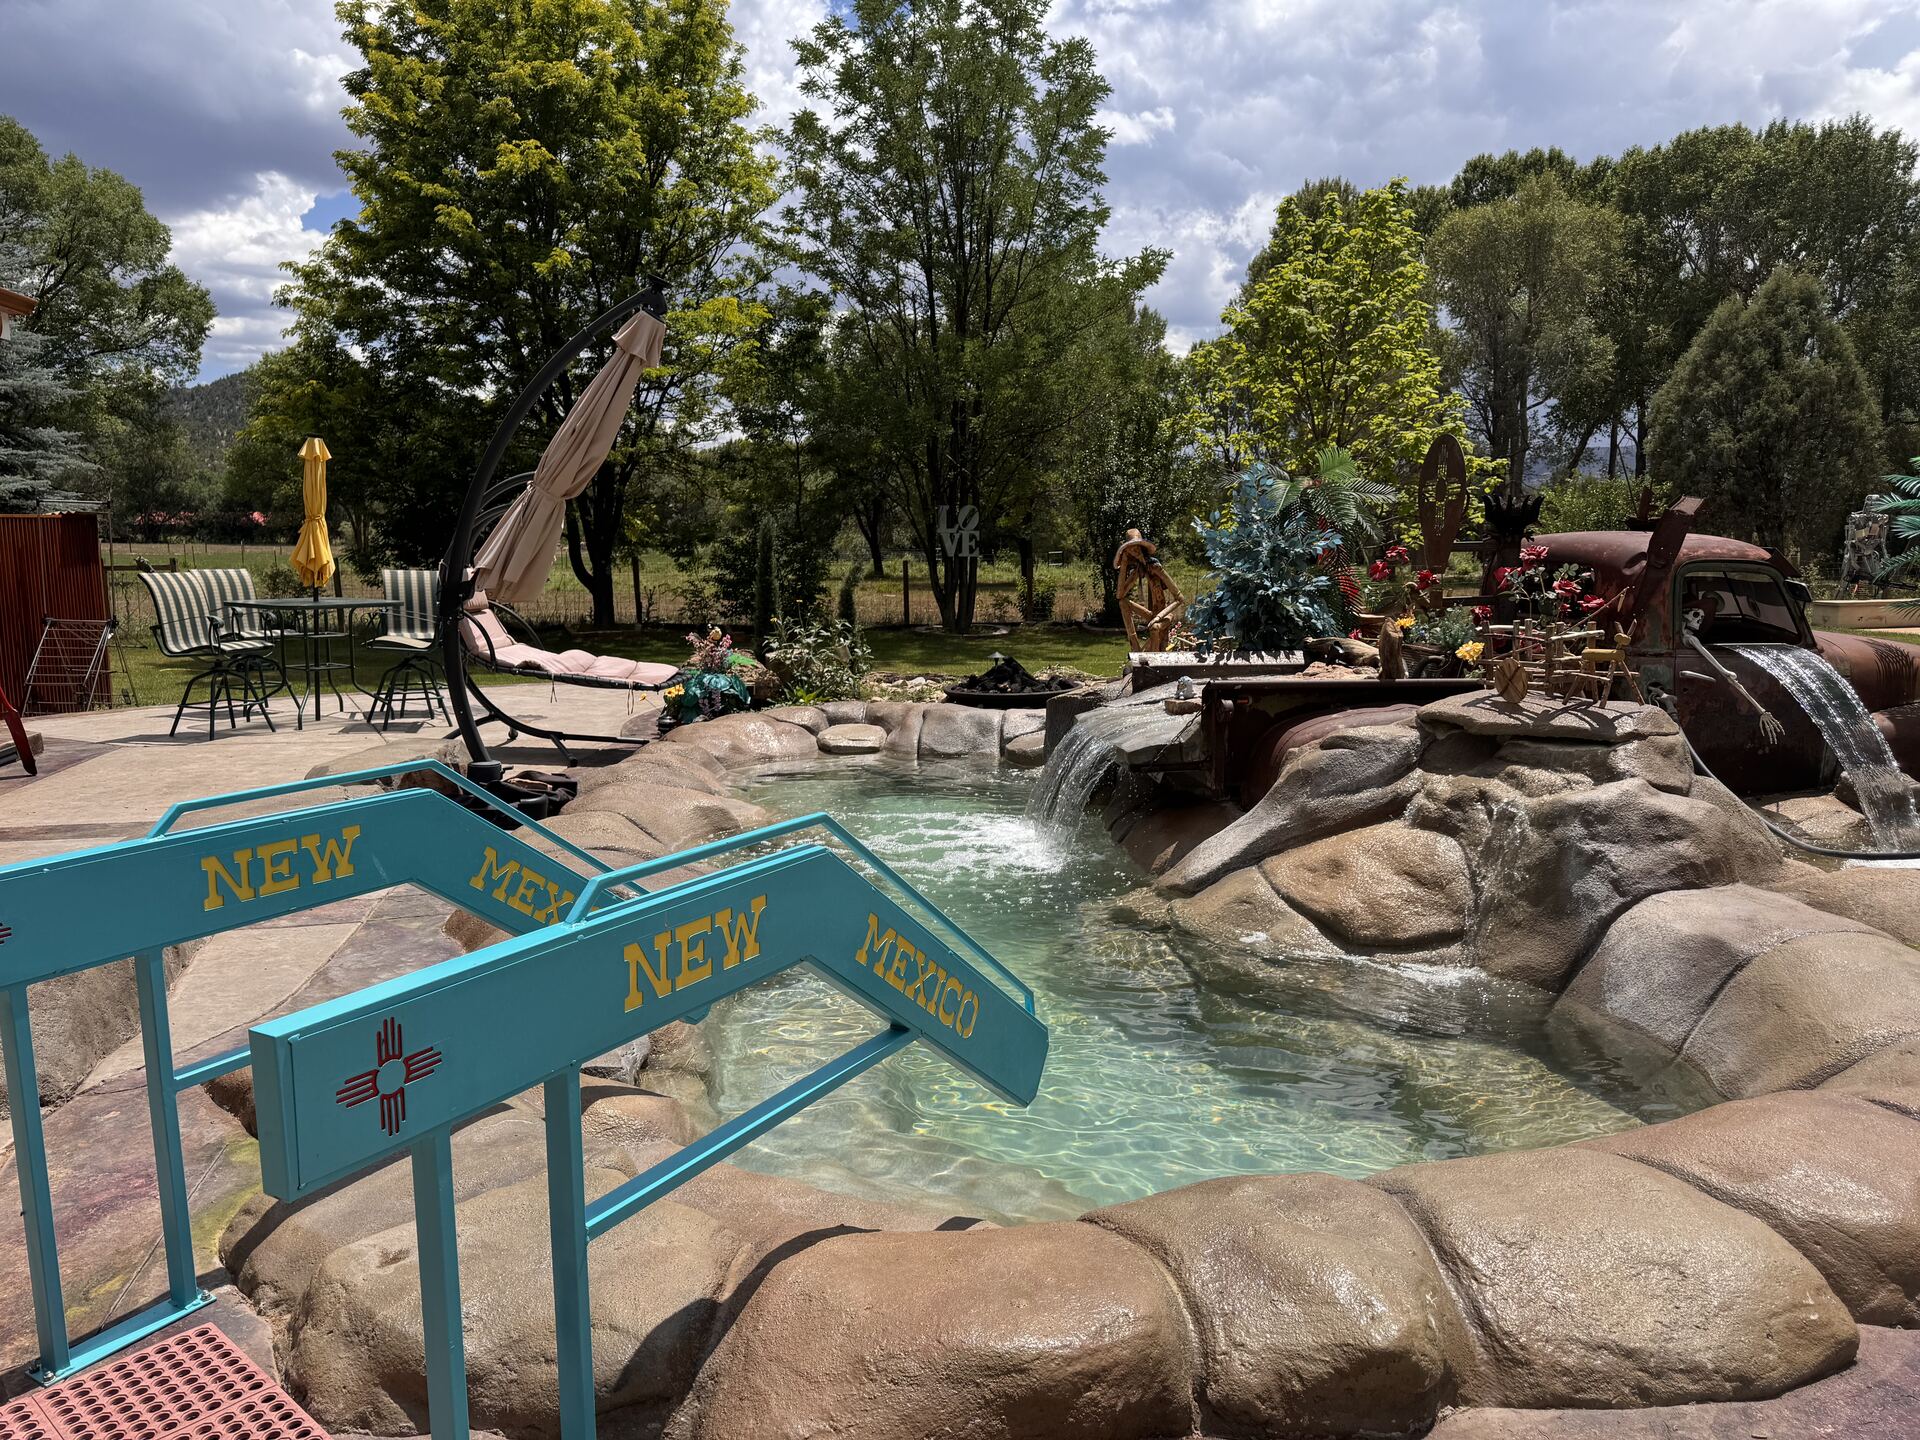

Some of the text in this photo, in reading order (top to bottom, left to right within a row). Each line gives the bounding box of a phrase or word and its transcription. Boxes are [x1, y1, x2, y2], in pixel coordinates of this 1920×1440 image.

[201, 824, 600, 925] NEW MEX
[623, 894, 980, 1038] NEW MEXICO
